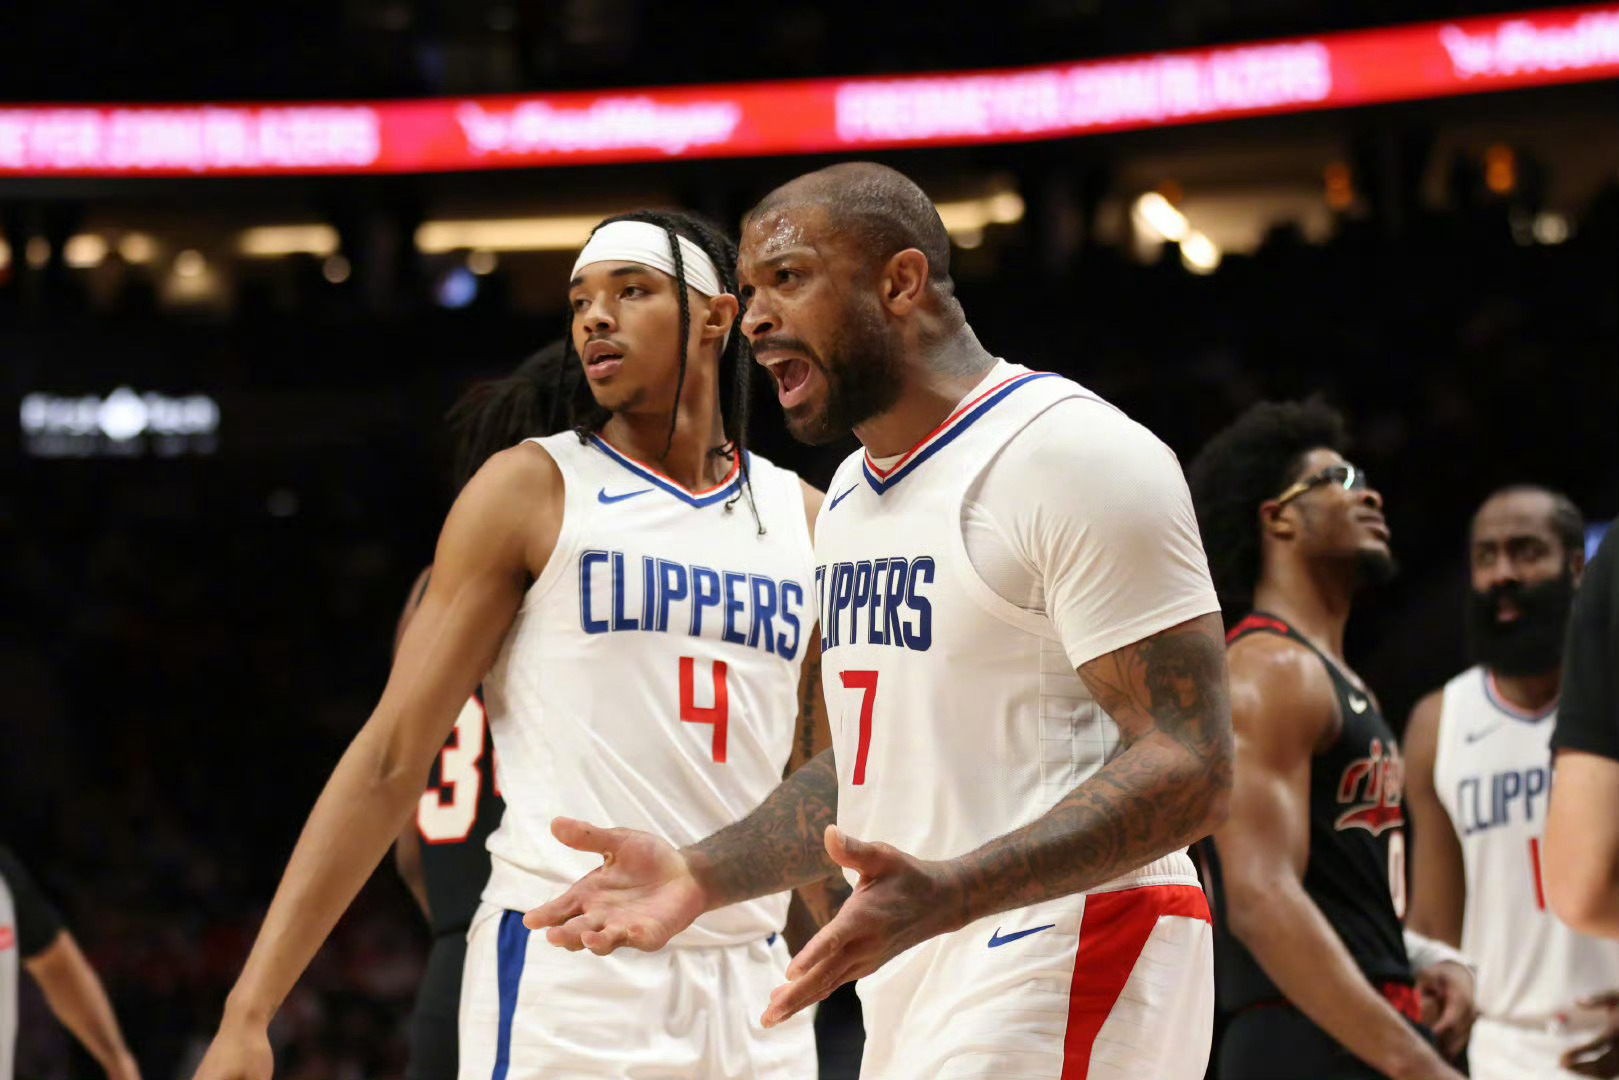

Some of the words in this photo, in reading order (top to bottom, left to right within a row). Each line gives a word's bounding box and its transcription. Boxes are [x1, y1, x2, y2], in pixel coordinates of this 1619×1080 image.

[579, 549, 803, 661] CLIPPERS
[679, 656, 728, 763] 4
[840, 670, 878, 785] 7
[416, 692, 502, 846] 3
[1457, 767, 1552, 834] CLIPP
